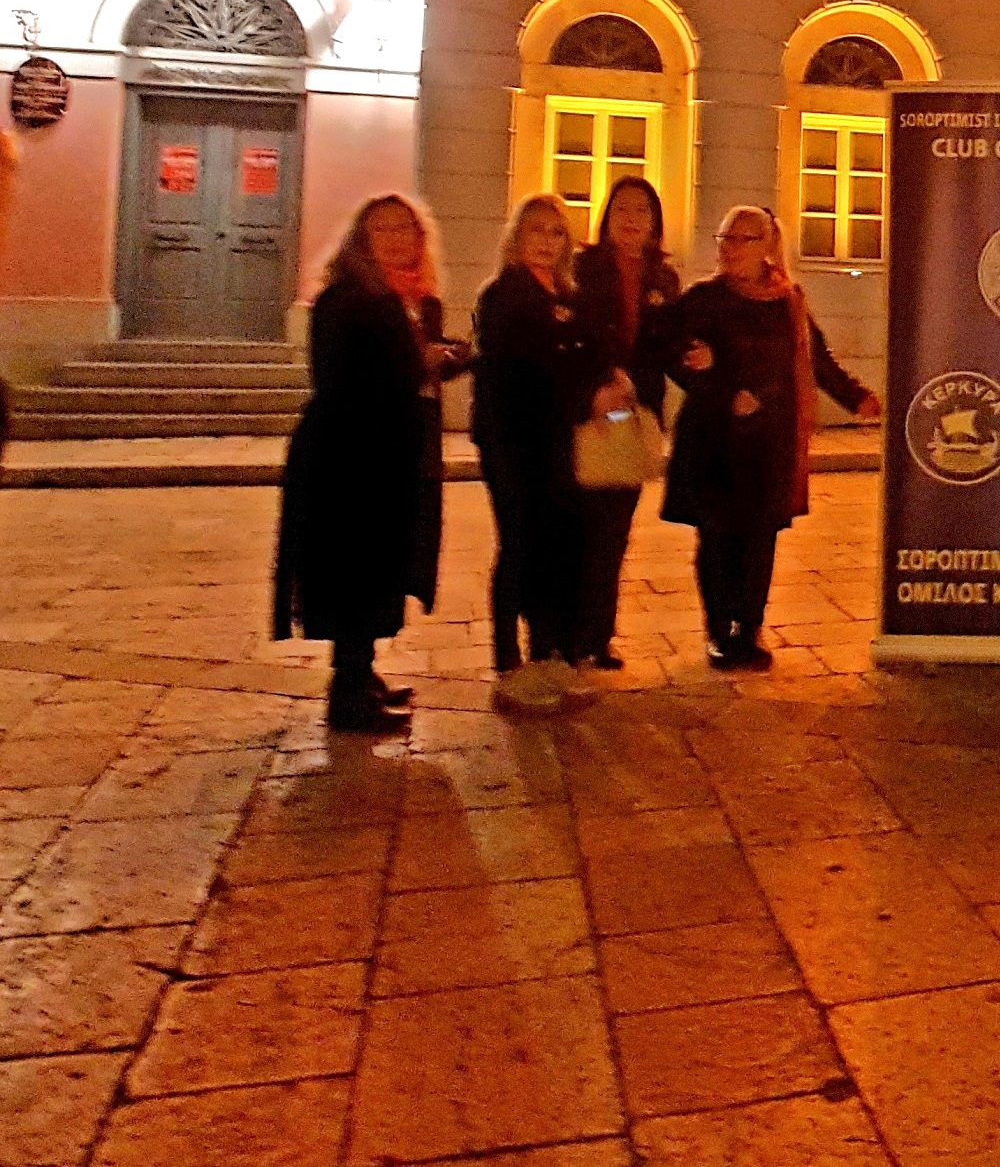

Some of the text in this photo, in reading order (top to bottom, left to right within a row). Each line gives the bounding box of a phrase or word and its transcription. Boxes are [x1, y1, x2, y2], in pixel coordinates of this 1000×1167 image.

[900, 113, 989, 128] SOROPTIMIST
[931, 138, 988, 158] CLUB
[898, 582, 987, 604] ΟΜΙΛΟΣ
